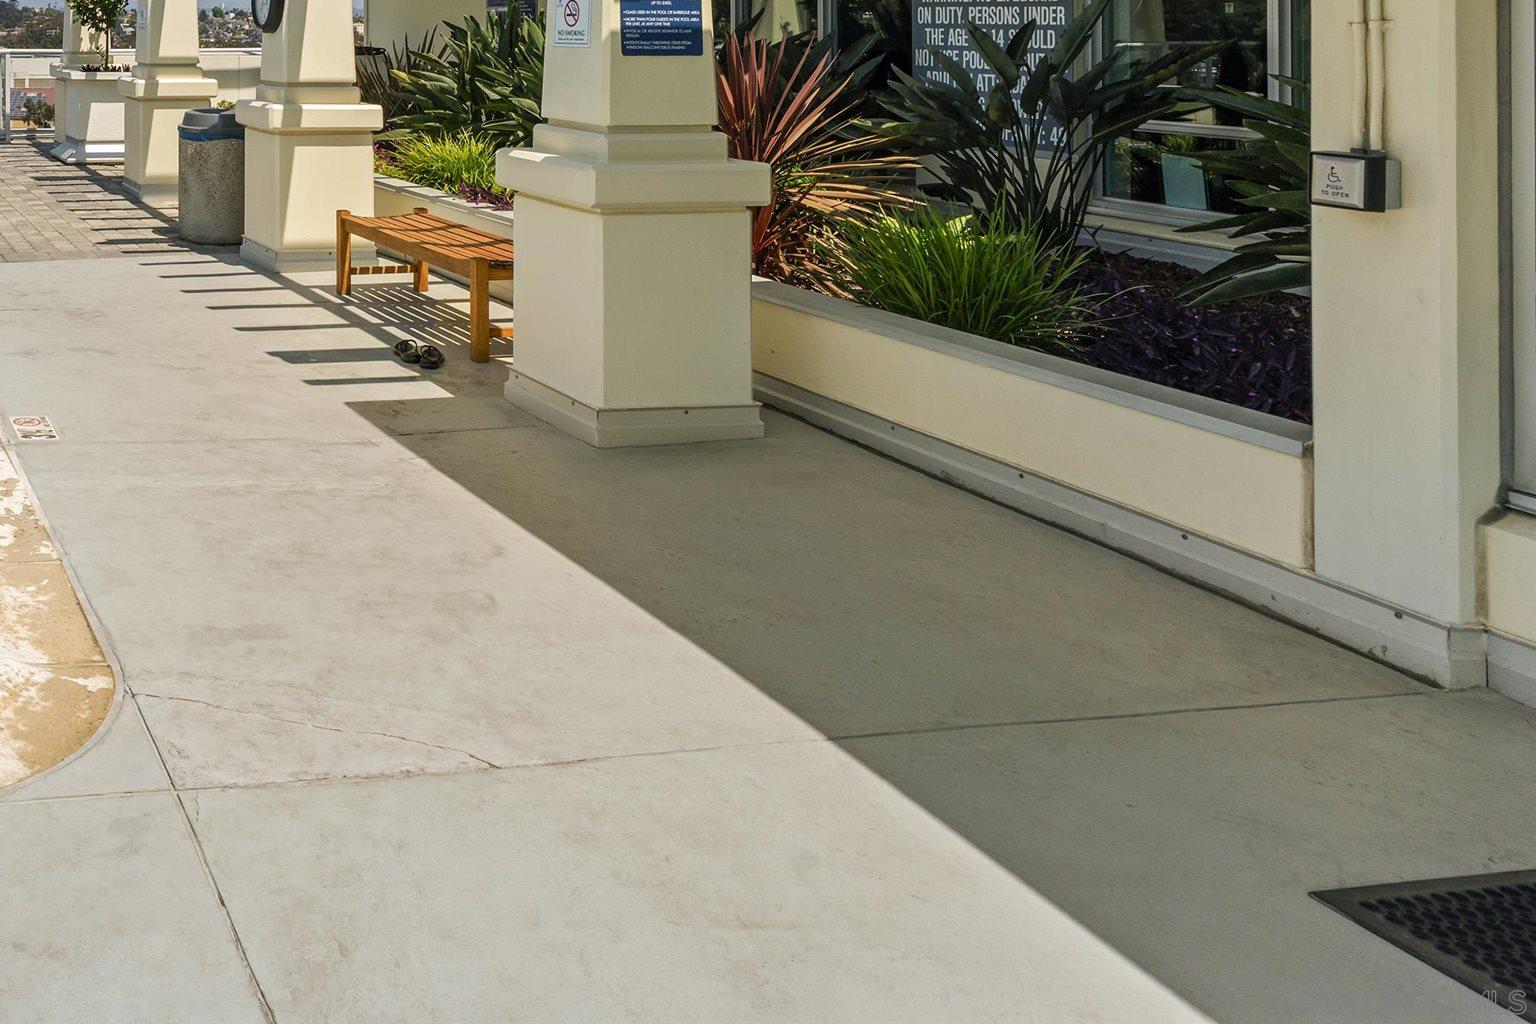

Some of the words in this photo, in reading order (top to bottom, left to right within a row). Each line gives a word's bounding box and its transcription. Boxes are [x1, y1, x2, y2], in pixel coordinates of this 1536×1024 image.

[917, 7, 931, 24] ON
[968, 6, 1020, 25] PERSONS
[1024, 6, 1065, 26] UNDER
[925, 28, 944, 46] THE
[948, 28, 968, 46] AGE
[991, 29, 1004, 47] 14
